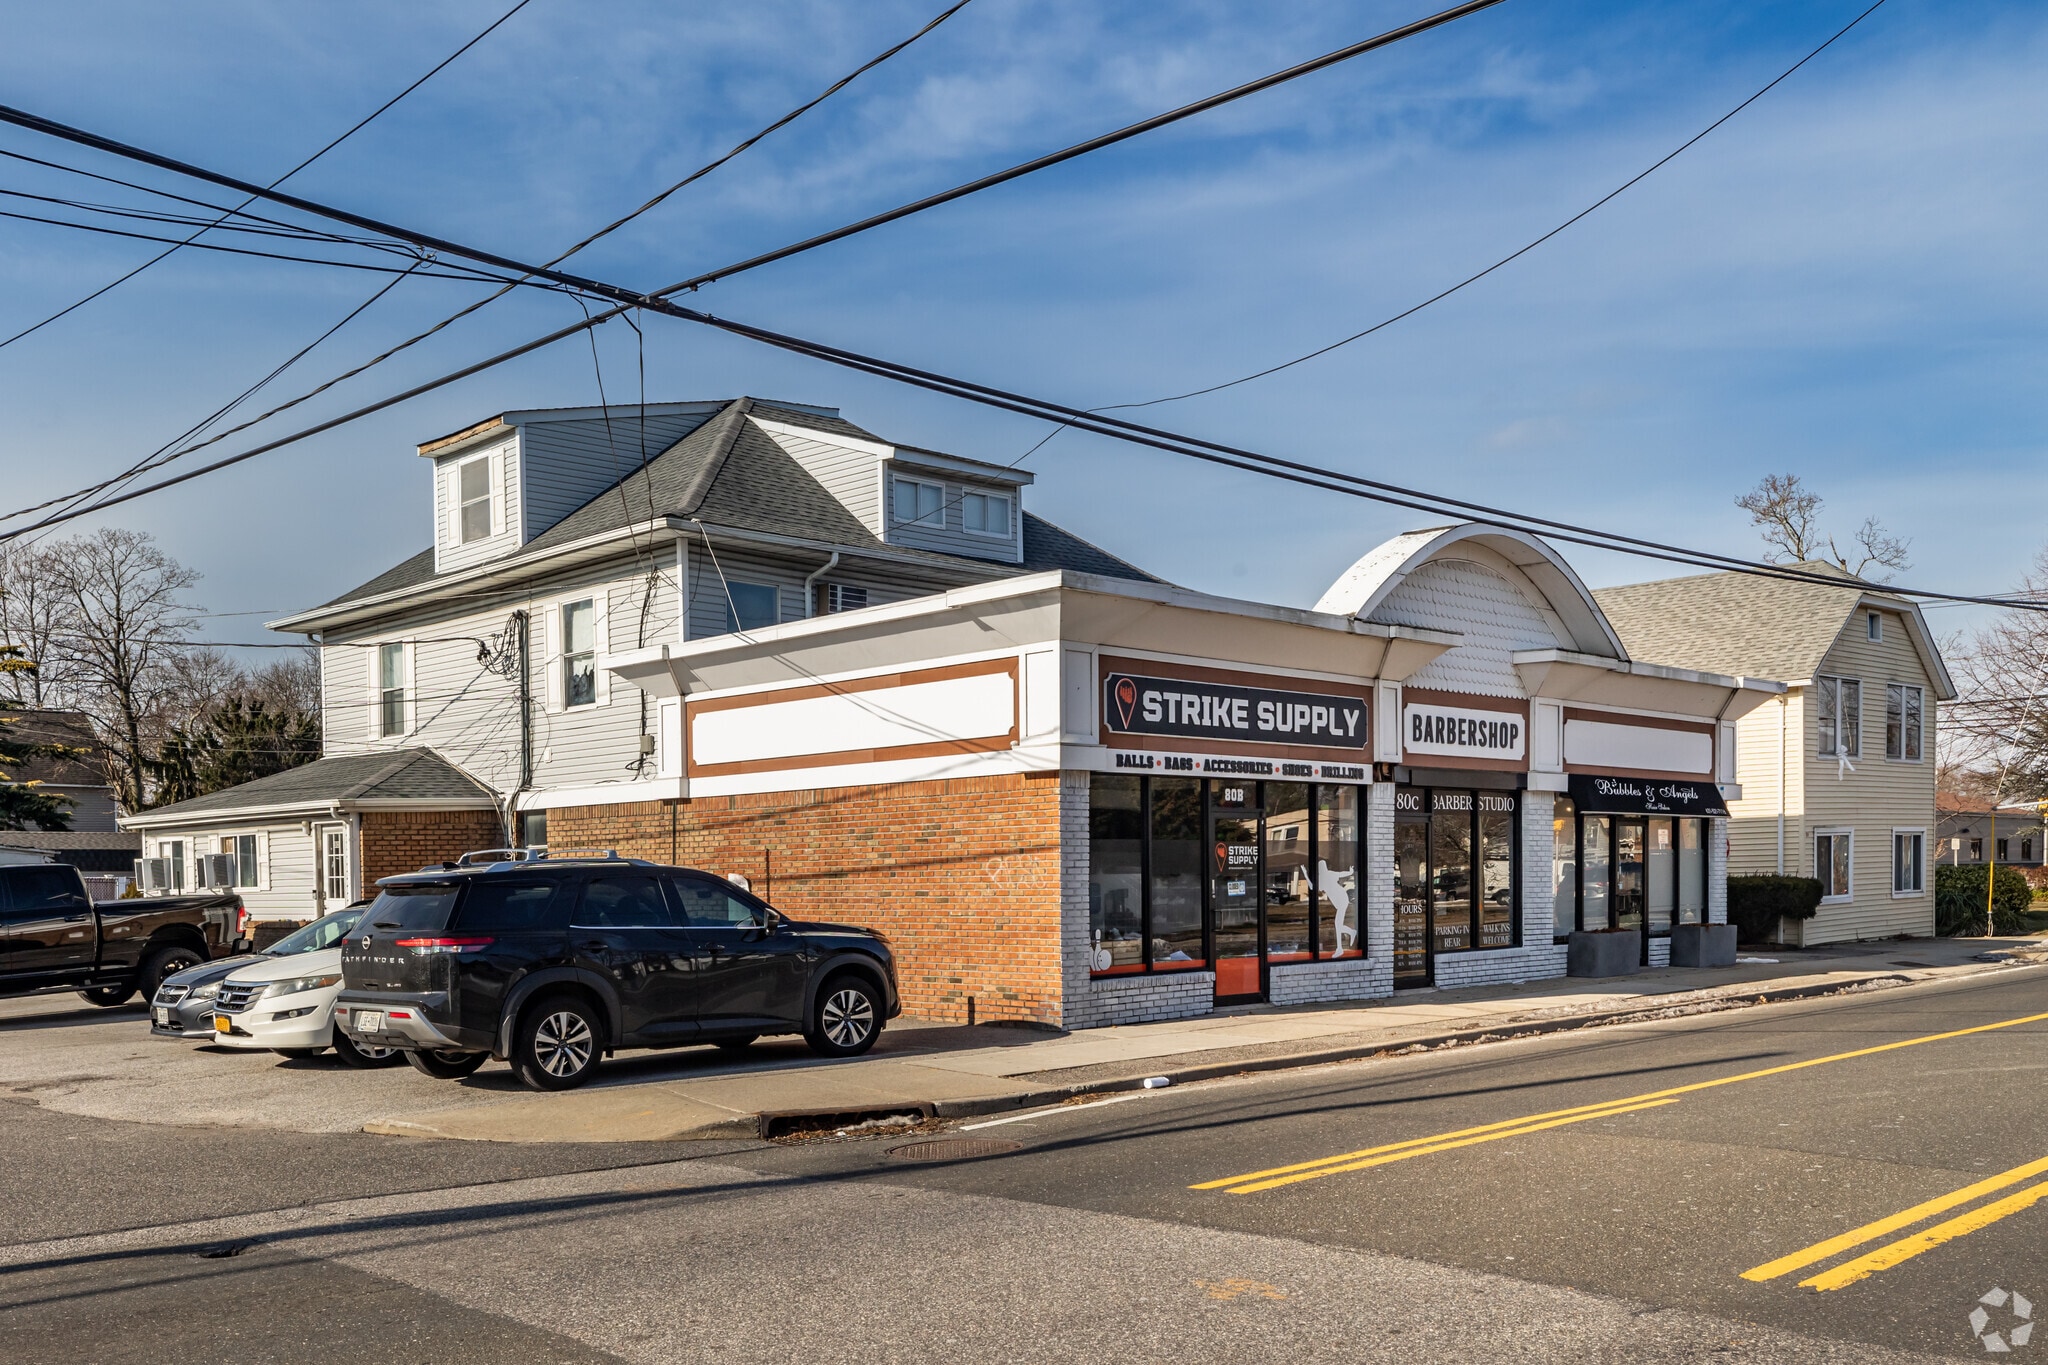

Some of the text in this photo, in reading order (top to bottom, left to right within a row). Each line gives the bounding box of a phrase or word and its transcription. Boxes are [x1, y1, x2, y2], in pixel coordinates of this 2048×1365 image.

[1142, 690, 1360, 737] STRIKE SUPPLY
[1412, 714, 1519, 749] BARBERSHOP
[1116, 754, 1364, 780] BALLS BAGS ACCESSORIES SHOES DRILLING
[1224, 788, 1244, 801] 80B
[1594, 779, 1698, 803] Bubbles & Angels
[1479, 796, 1515, 811] STUDIO
[1228, 846, 1258, 855] STRIKE
[1228, 856, 1258, 864] SUPPLY
[1435, 926, 1462, 936] PARKING
[1444, 938, 1460, 947] REAR
